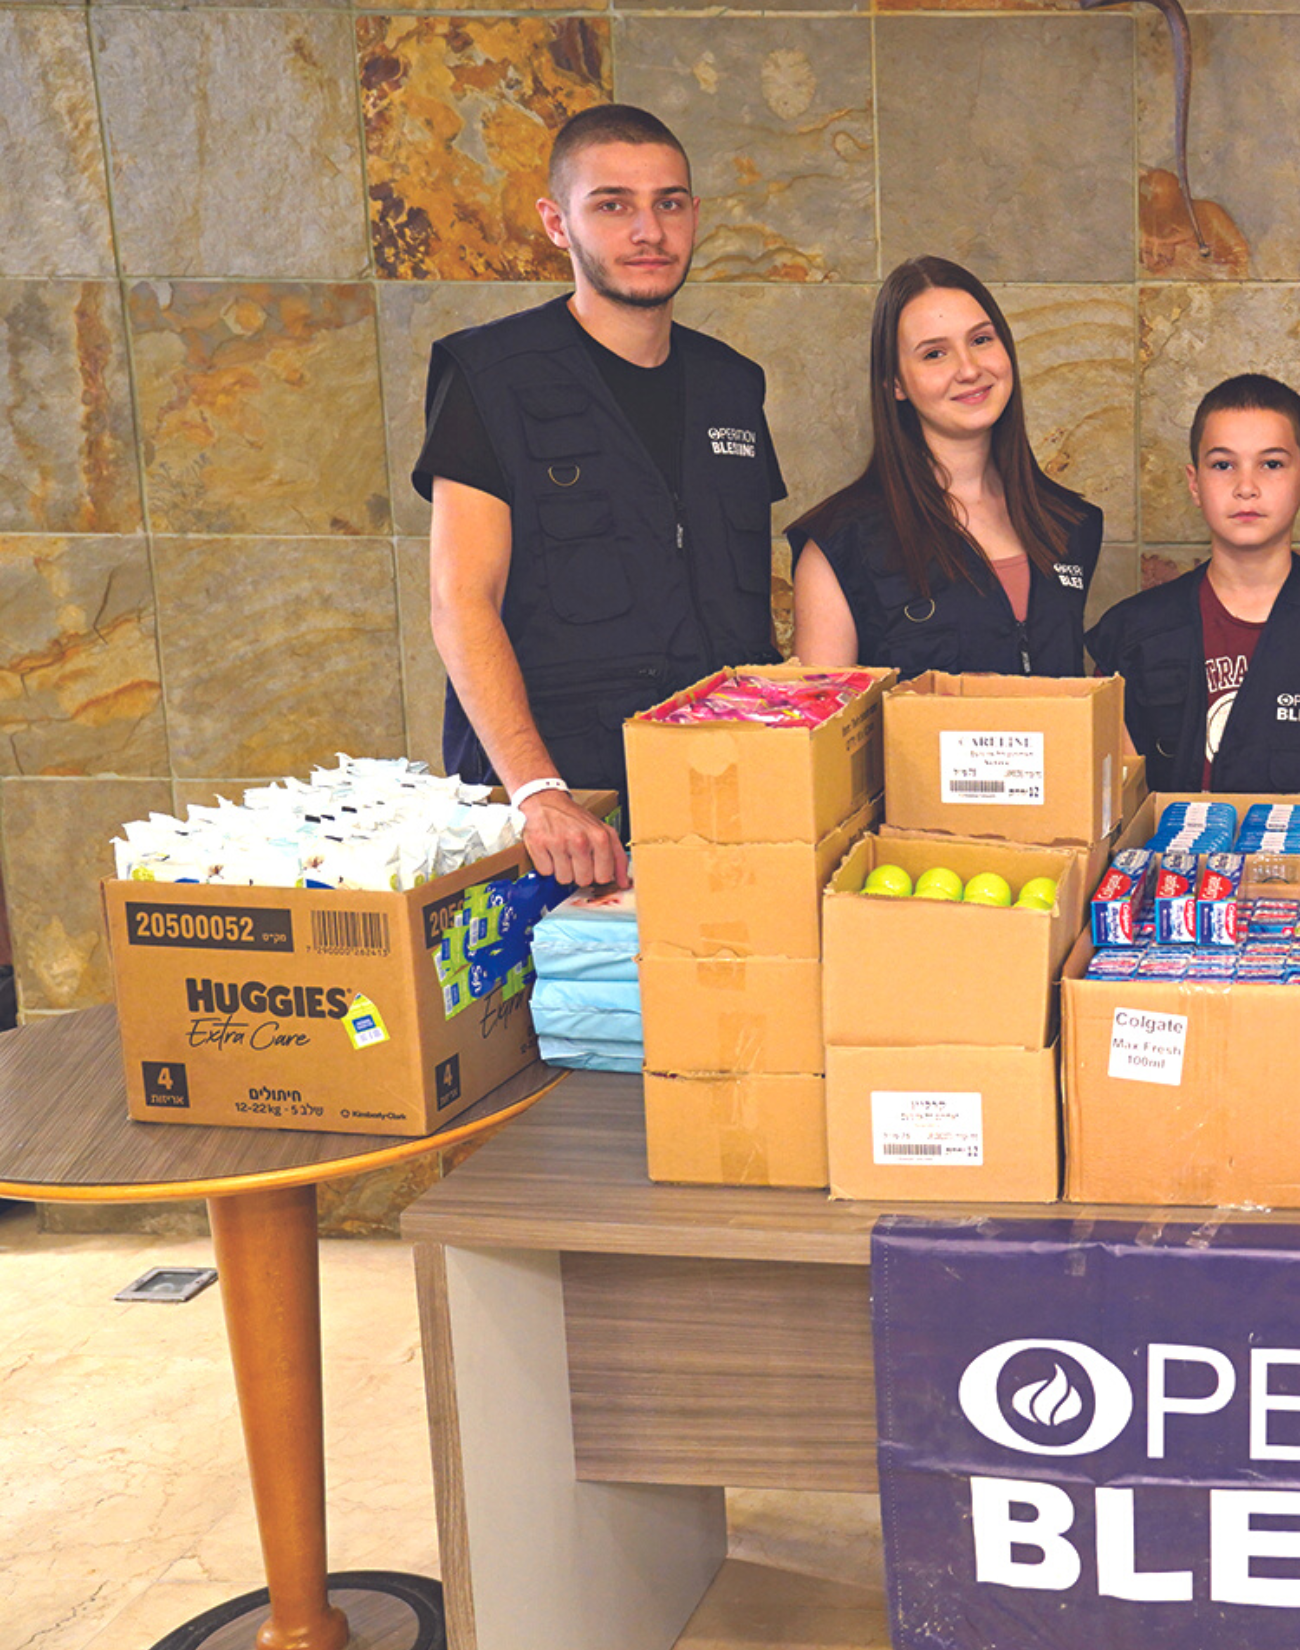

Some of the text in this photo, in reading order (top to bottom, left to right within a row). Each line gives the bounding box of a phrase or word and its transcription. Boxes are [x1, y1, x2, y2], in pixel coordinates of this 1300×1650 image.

[136, 911, 255, 942] 20500052
[186, 977, 349, 1020] HUGGIES
[186, 1015, 311, 1051] Extra Care
[1116, 1012, 1183, 1034] Colgate
[1112, 1038, 1181, 1056] Max Fresh
[1127, 1055, 1165, 1069] 100ml
[157, 1067, 174, 1090] 4
[248, 1086, 302, 1102] חיתולים
